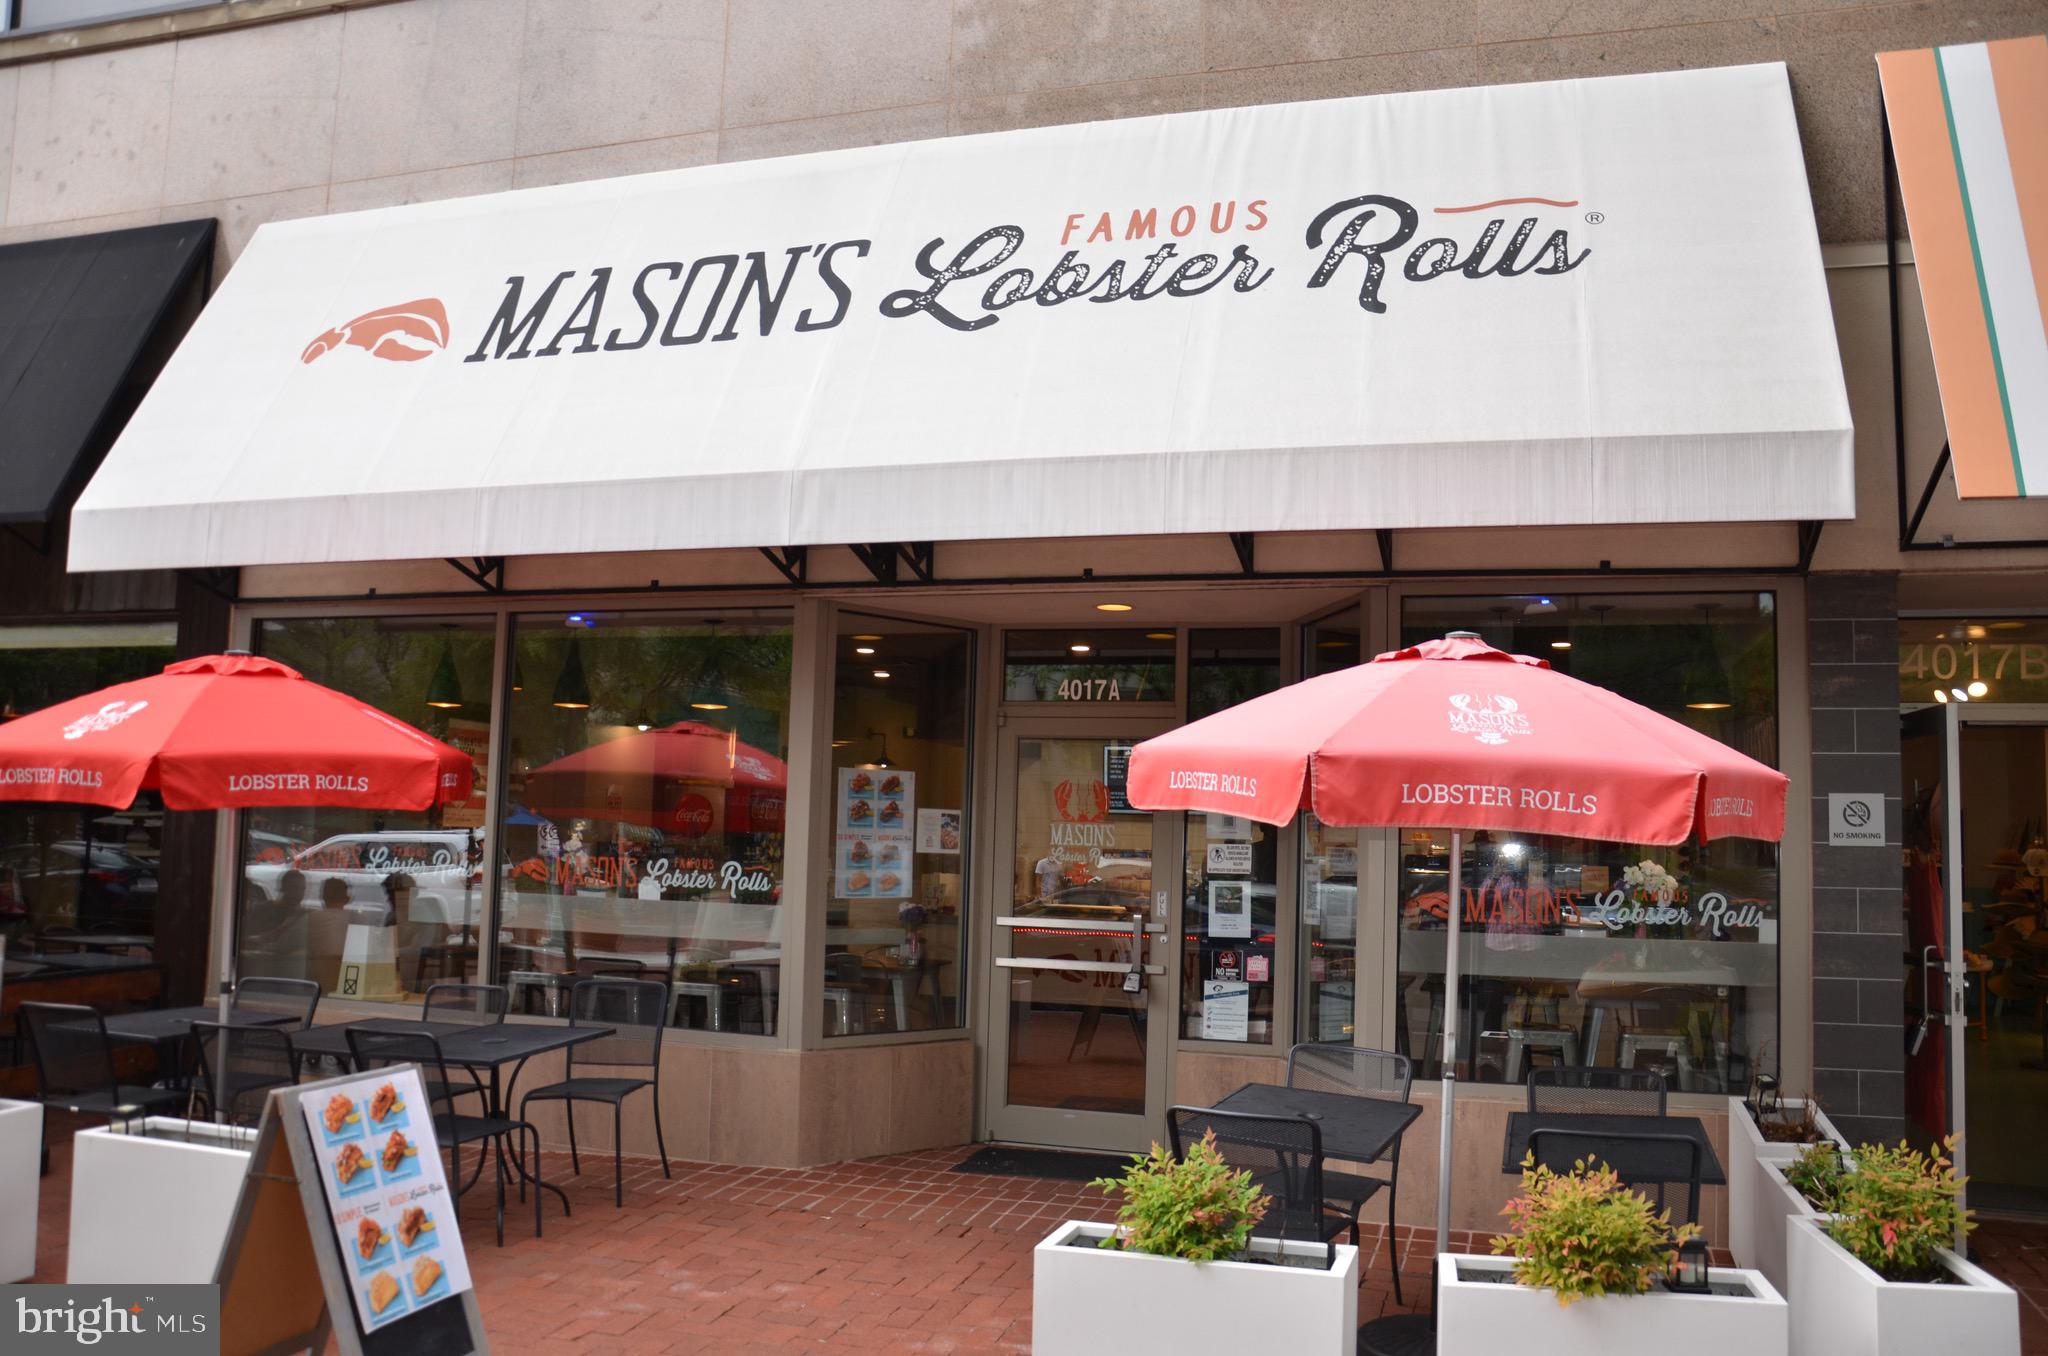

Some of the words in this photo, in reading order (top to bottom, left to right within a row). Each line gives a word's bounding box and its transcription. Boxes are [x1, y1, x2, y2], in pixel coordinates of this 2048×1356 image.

[1060, 200, 1270, 246] FAMOUS
[463, 239, 871, 363] MASON'S
[879, 225, 1275, 332] Lobster
[1899, 643, 2048, 680] 4017B
[1058, 679, 1120, 701] 4017A
[0, 767, 55, 785] LOBSTER
[57, 767, 103, 788] ROLLS
[229, 774, 309, 791] LOBSTER
[315, 775, 369, 792] ROLLS
[1169, 771, 1218, 791] LOBSTER
[1220, 775, 1257, 797] ROLLS
[1401, 783, 1513, 807] LOBSTER
[1519, 788, 1598, 815] ROLLS
[1832, 832, 1844, 840] NO
[1845, 832, 1881, 840] SMOKING
[674, 857, 714, 869] FAMOUS
[555, 856, 638, 888] MASON'S
[640, 858, 716, 892] Lobster
[720, 861, 772, 898] Rolls
[1462, 887, 1582, 926] MASON'S
[1589, 889, 1692, 930] Lobster
[1698, 892, 1764, 937] Rolls
[1215, 967, 1225, 976] NO
